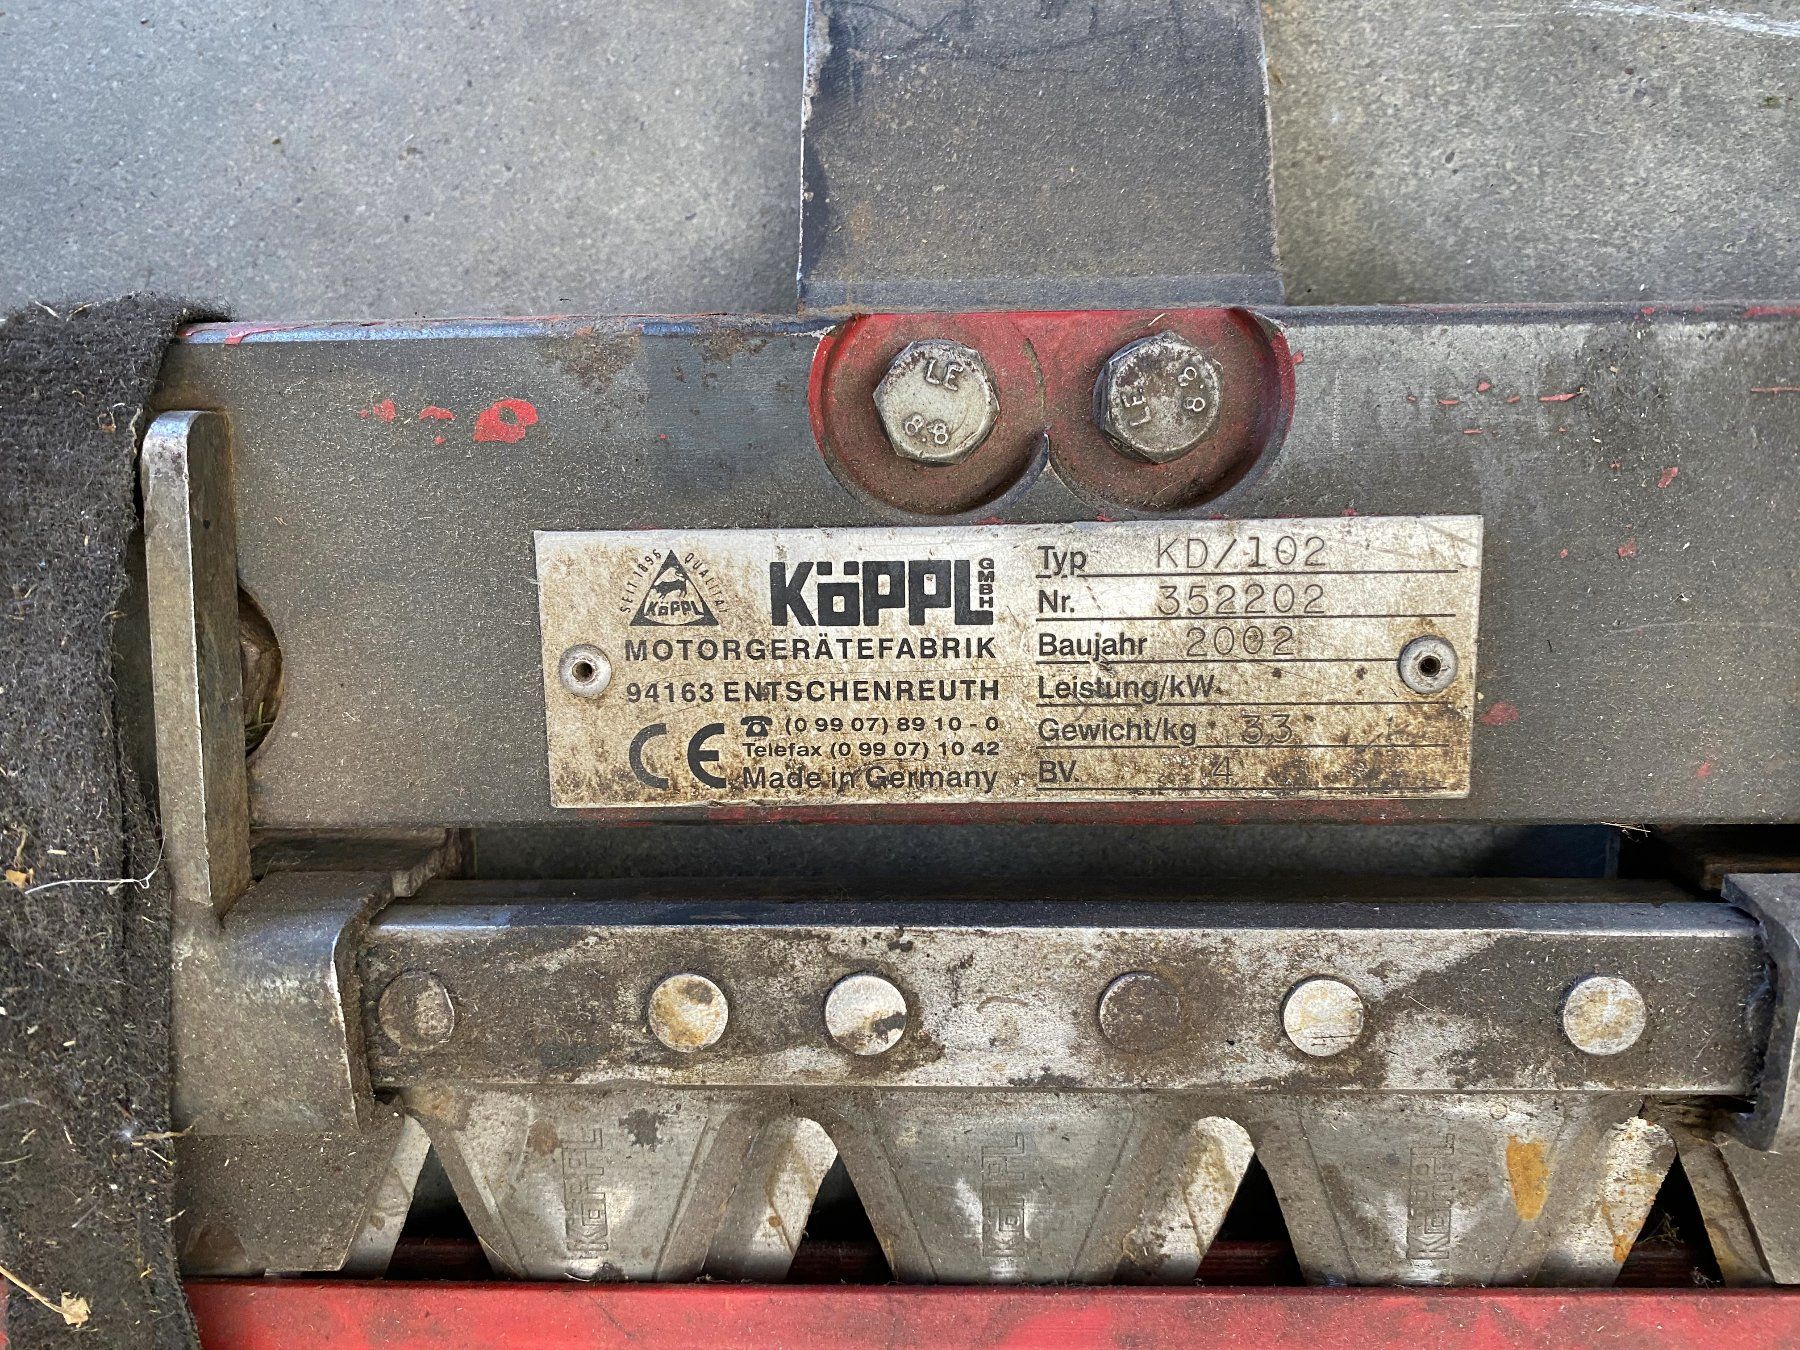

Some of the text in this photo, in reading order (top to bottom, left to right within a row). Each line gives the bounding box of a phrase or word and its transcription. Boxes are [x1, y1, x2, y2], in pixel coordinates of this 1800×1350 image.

[1037, 536, 1327, 576] Typ KD/102
[620, 548, 662, 613] SEIT 1896
[977, 556, 995, 608] GMBH
[1038, 583, 1327, 616] Nr. 352202
[625, 632, 997, 662] MOTORGERÄTEFABRIK
[1038, 625, 1295, 663] Baujahr 2002
[626, 679, 1000, 703] 94163 ENTSCHENREUTH
[1038, 675, 1214, 705] Leistung/kW
[785, 716, 807, 735] (0
[814, 717, 844, 733] 99
[851, 716, 889, 735] 07)
[896, 717, 926, 732] 89
[935, 716, 962, 732] 10
[985, 716, 999, 731] 0
[1038, 717, 1197, 746] Gewicht/kg
[628, 722, 727, 790] CE
[743, 741, 1000, 759] Telefax (0 99 07) 10 42
[743, 765, 998, 793] Made in Germany
[1211, 756, 1233, 784] 4
